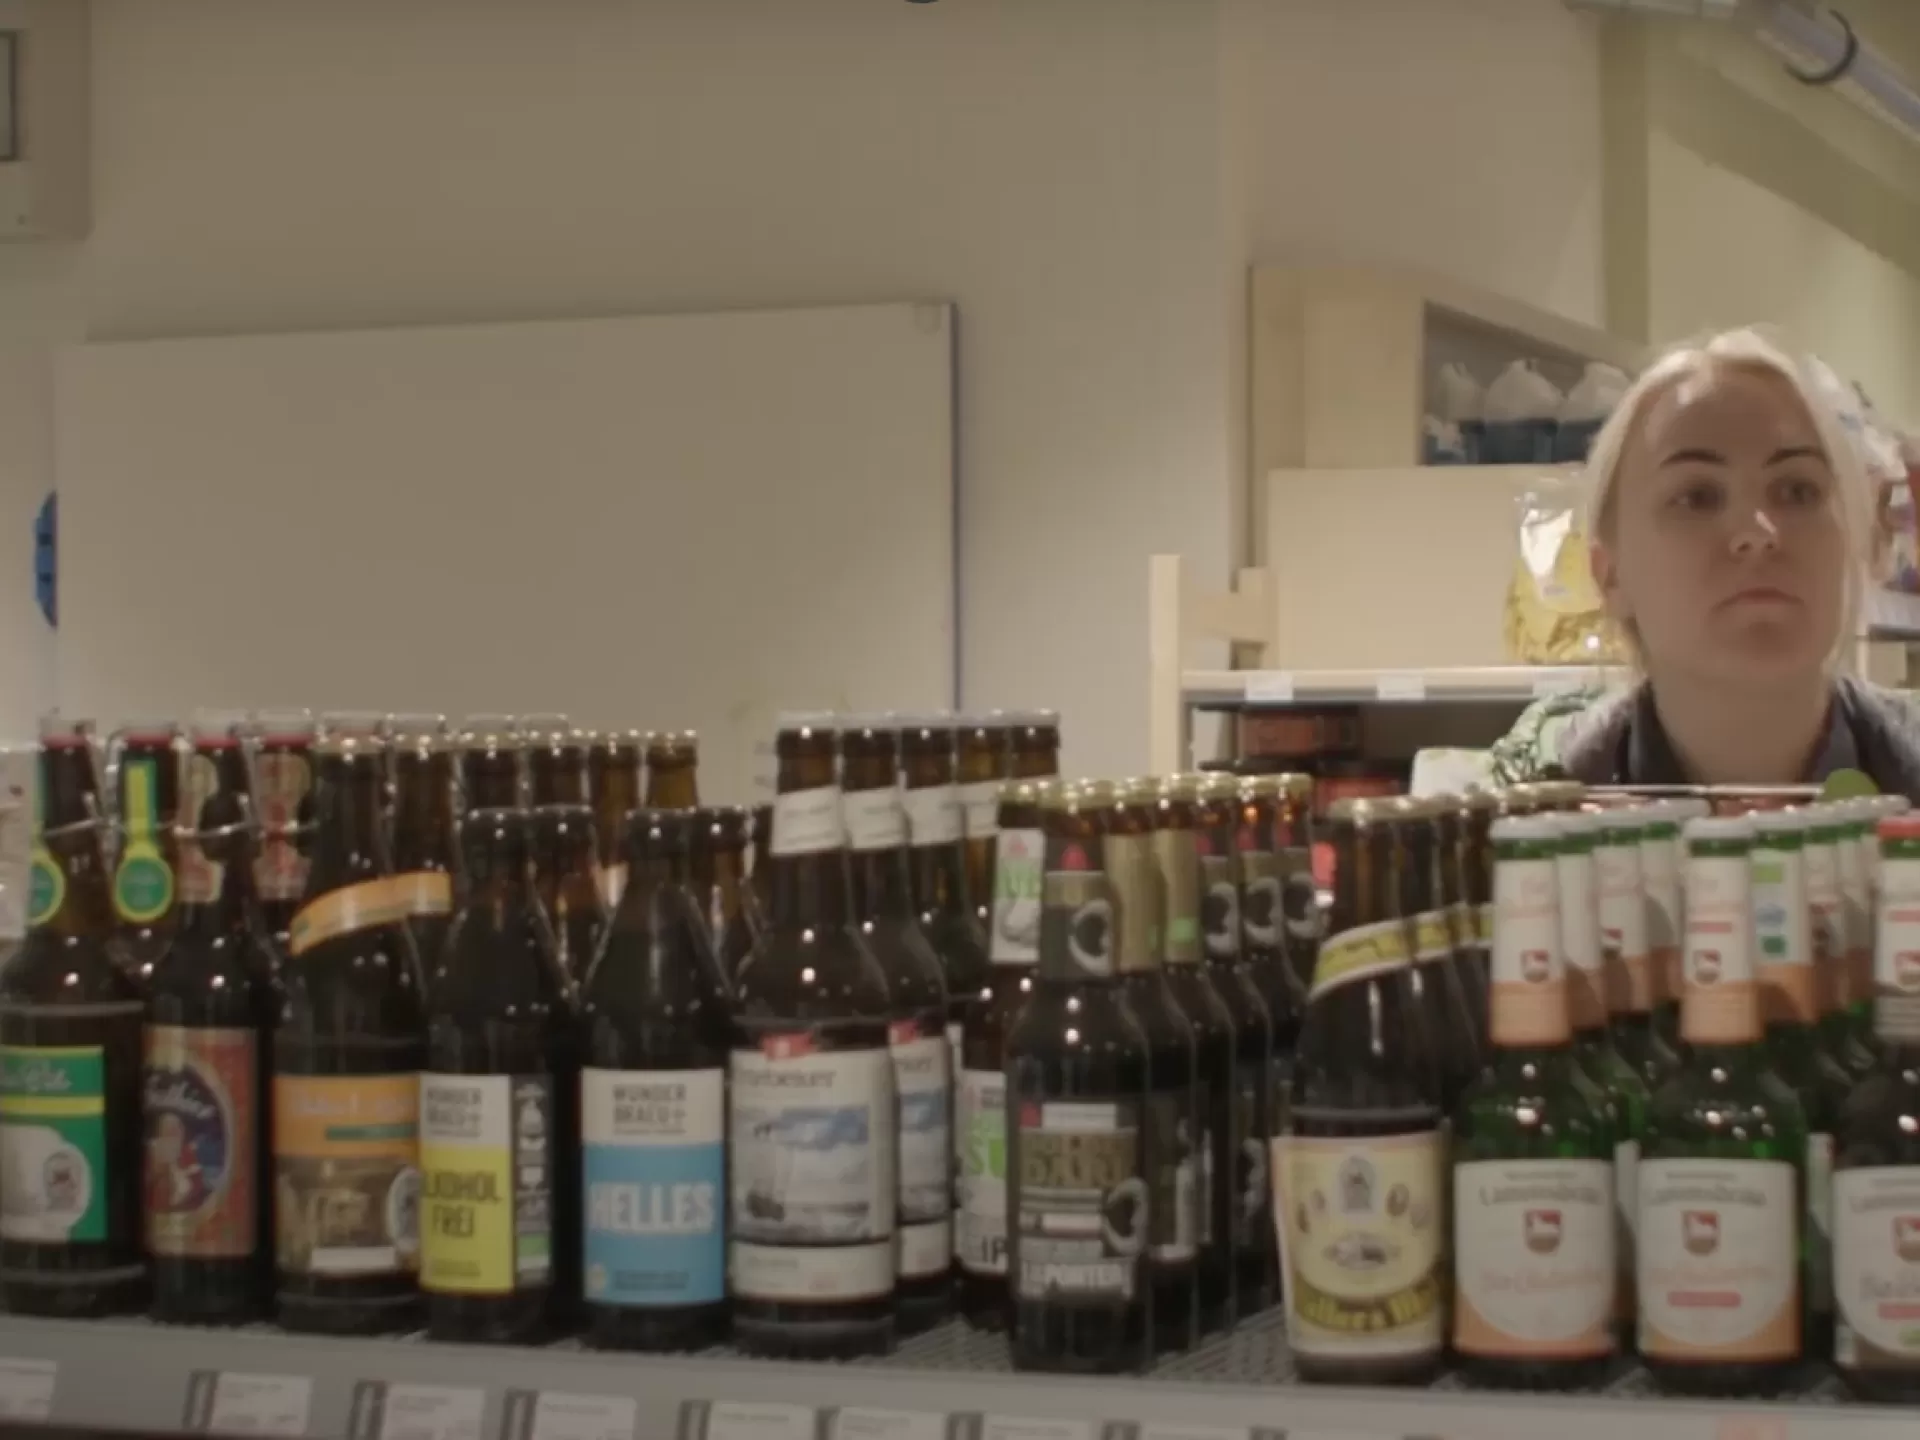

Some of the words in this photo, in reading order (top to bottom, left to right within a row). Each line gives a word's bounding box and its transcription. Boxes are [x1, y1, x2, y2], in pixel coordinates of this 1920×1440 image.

[612, 1083, 687, 1101] WUNDER
[432, 1205, 476, 1238] FREI
[589, 1180, 717, 1233] HELLES
